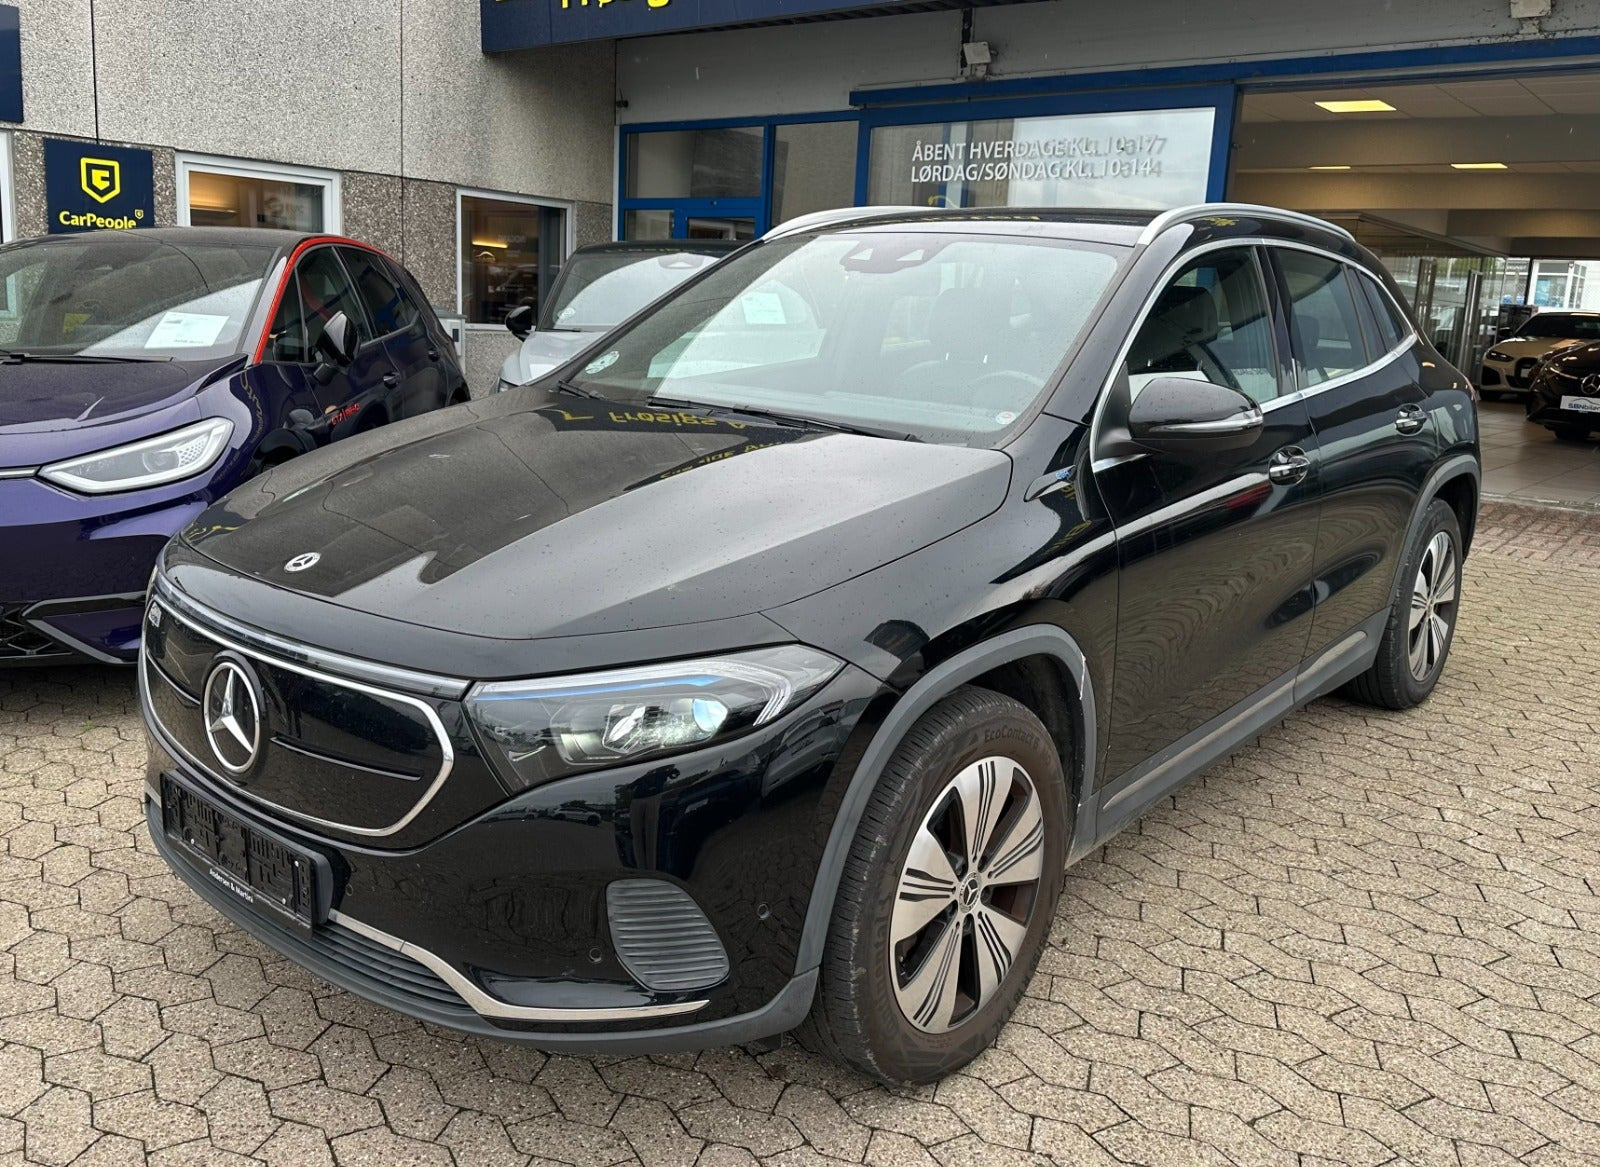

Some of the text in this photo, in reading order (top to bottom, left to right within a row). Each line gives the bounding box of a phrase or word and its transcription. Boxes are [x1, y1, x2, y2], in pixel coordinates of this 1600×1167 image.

[911, 140, 966, 161] ÅBENT
[969, 138, 1065, 160] HVERDAGE
[911, 159, 1060, 183] LØRDAG/SØNDAG
[59, 210, 137, 230] CarPeople
